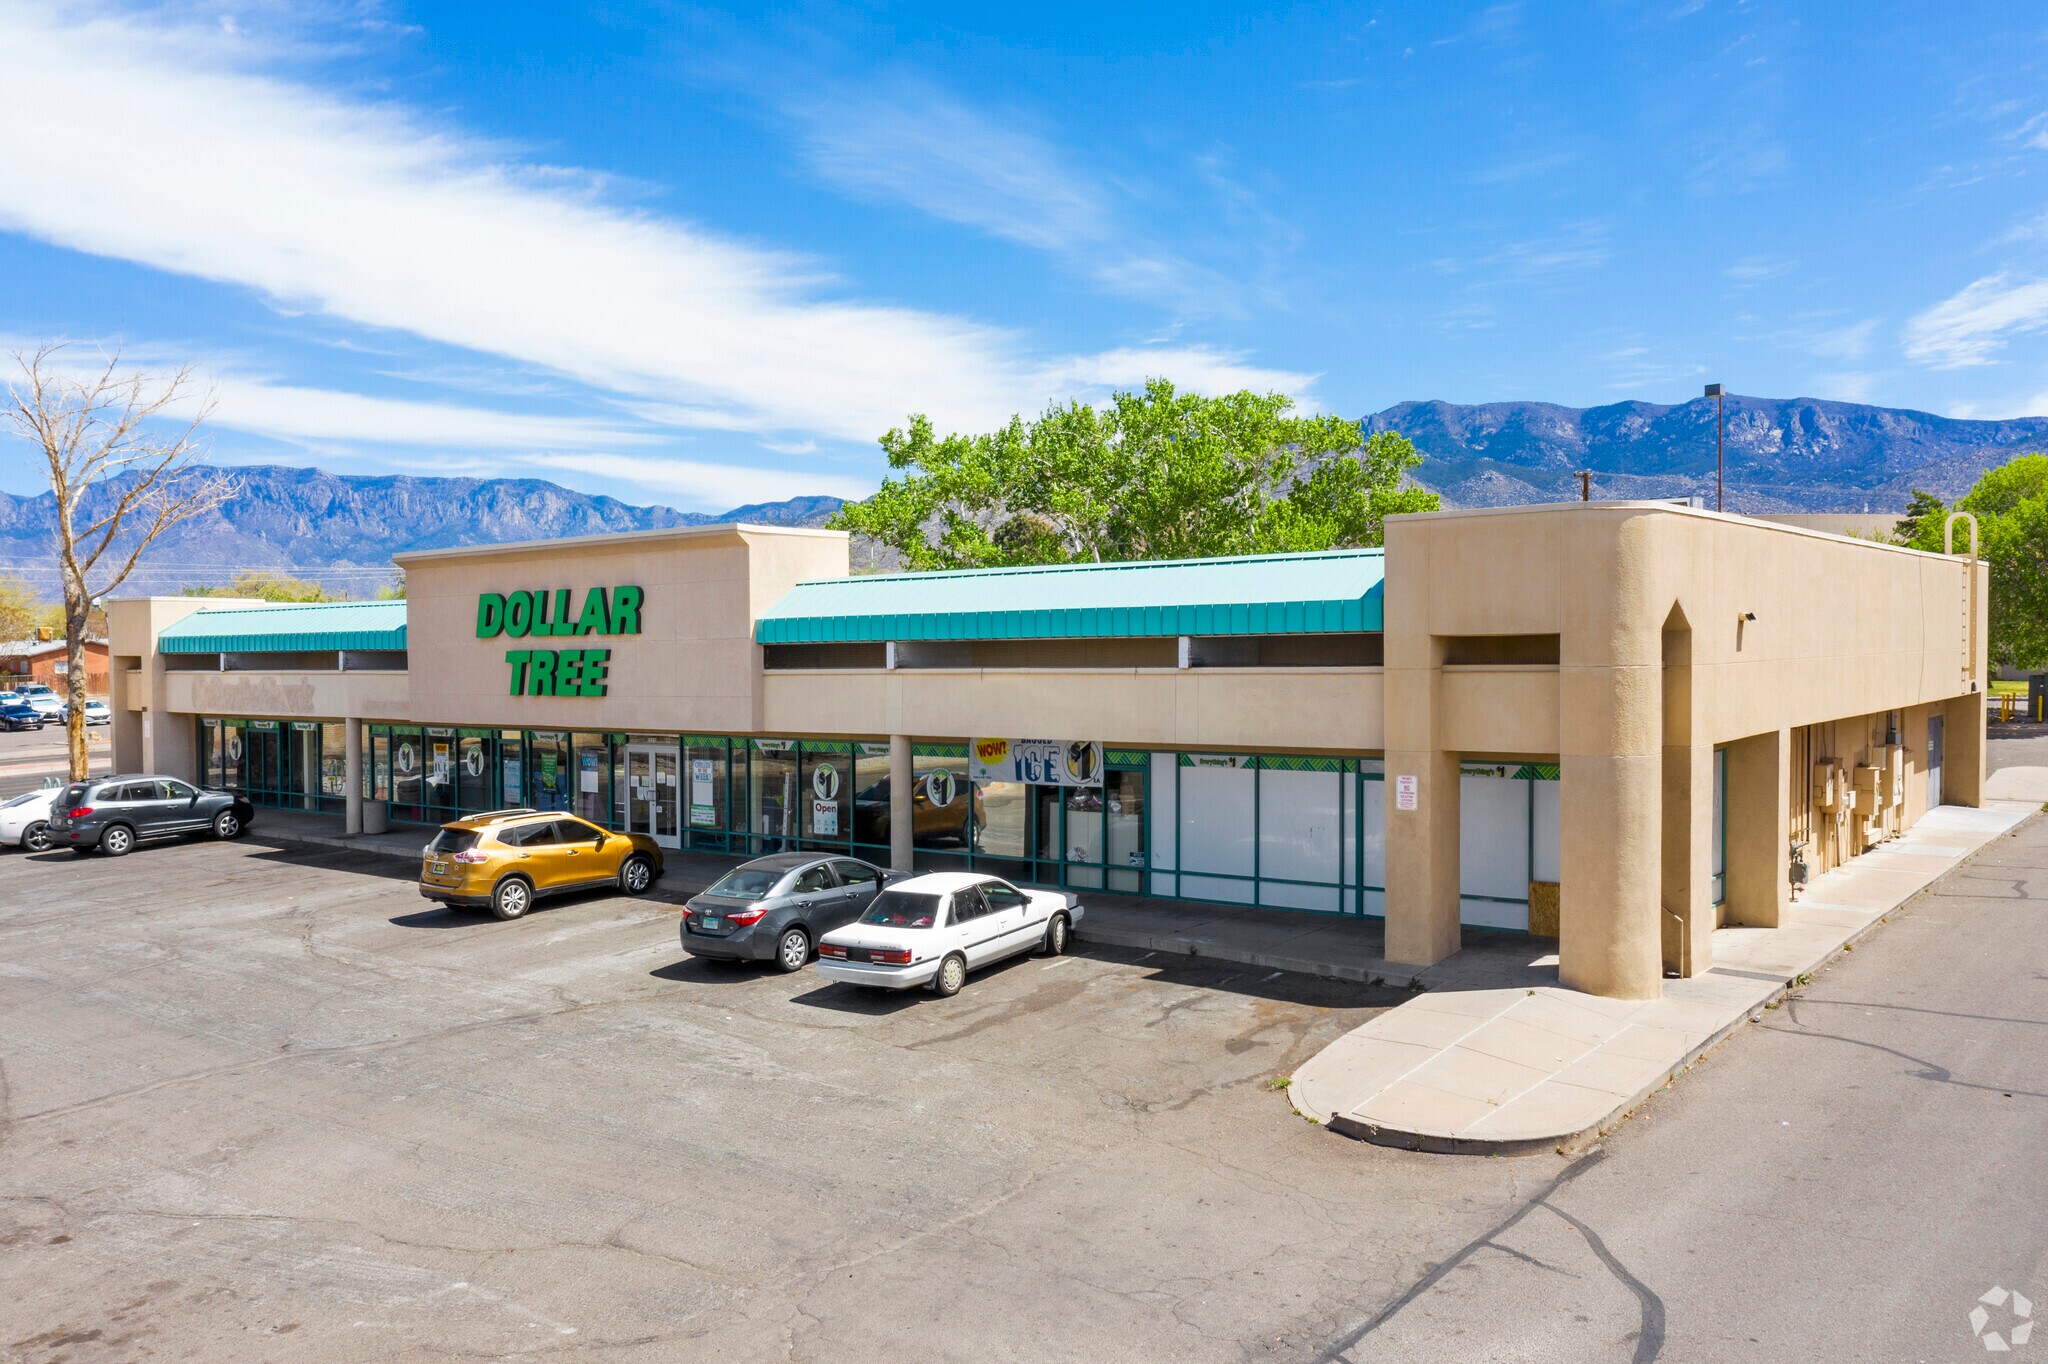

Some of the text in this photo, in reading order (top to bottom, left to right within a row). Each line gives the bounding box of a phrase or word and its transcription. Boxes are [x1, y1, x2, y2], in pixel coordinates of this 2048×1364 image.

[476, 585, 645, 638] DOLLAR
[505, 649, 611, 696] TREE
[976, 741, 1007, 757] WOW!
[1013, 744, 1060, 782] ICE
[815, 803, 837, 814] Open
